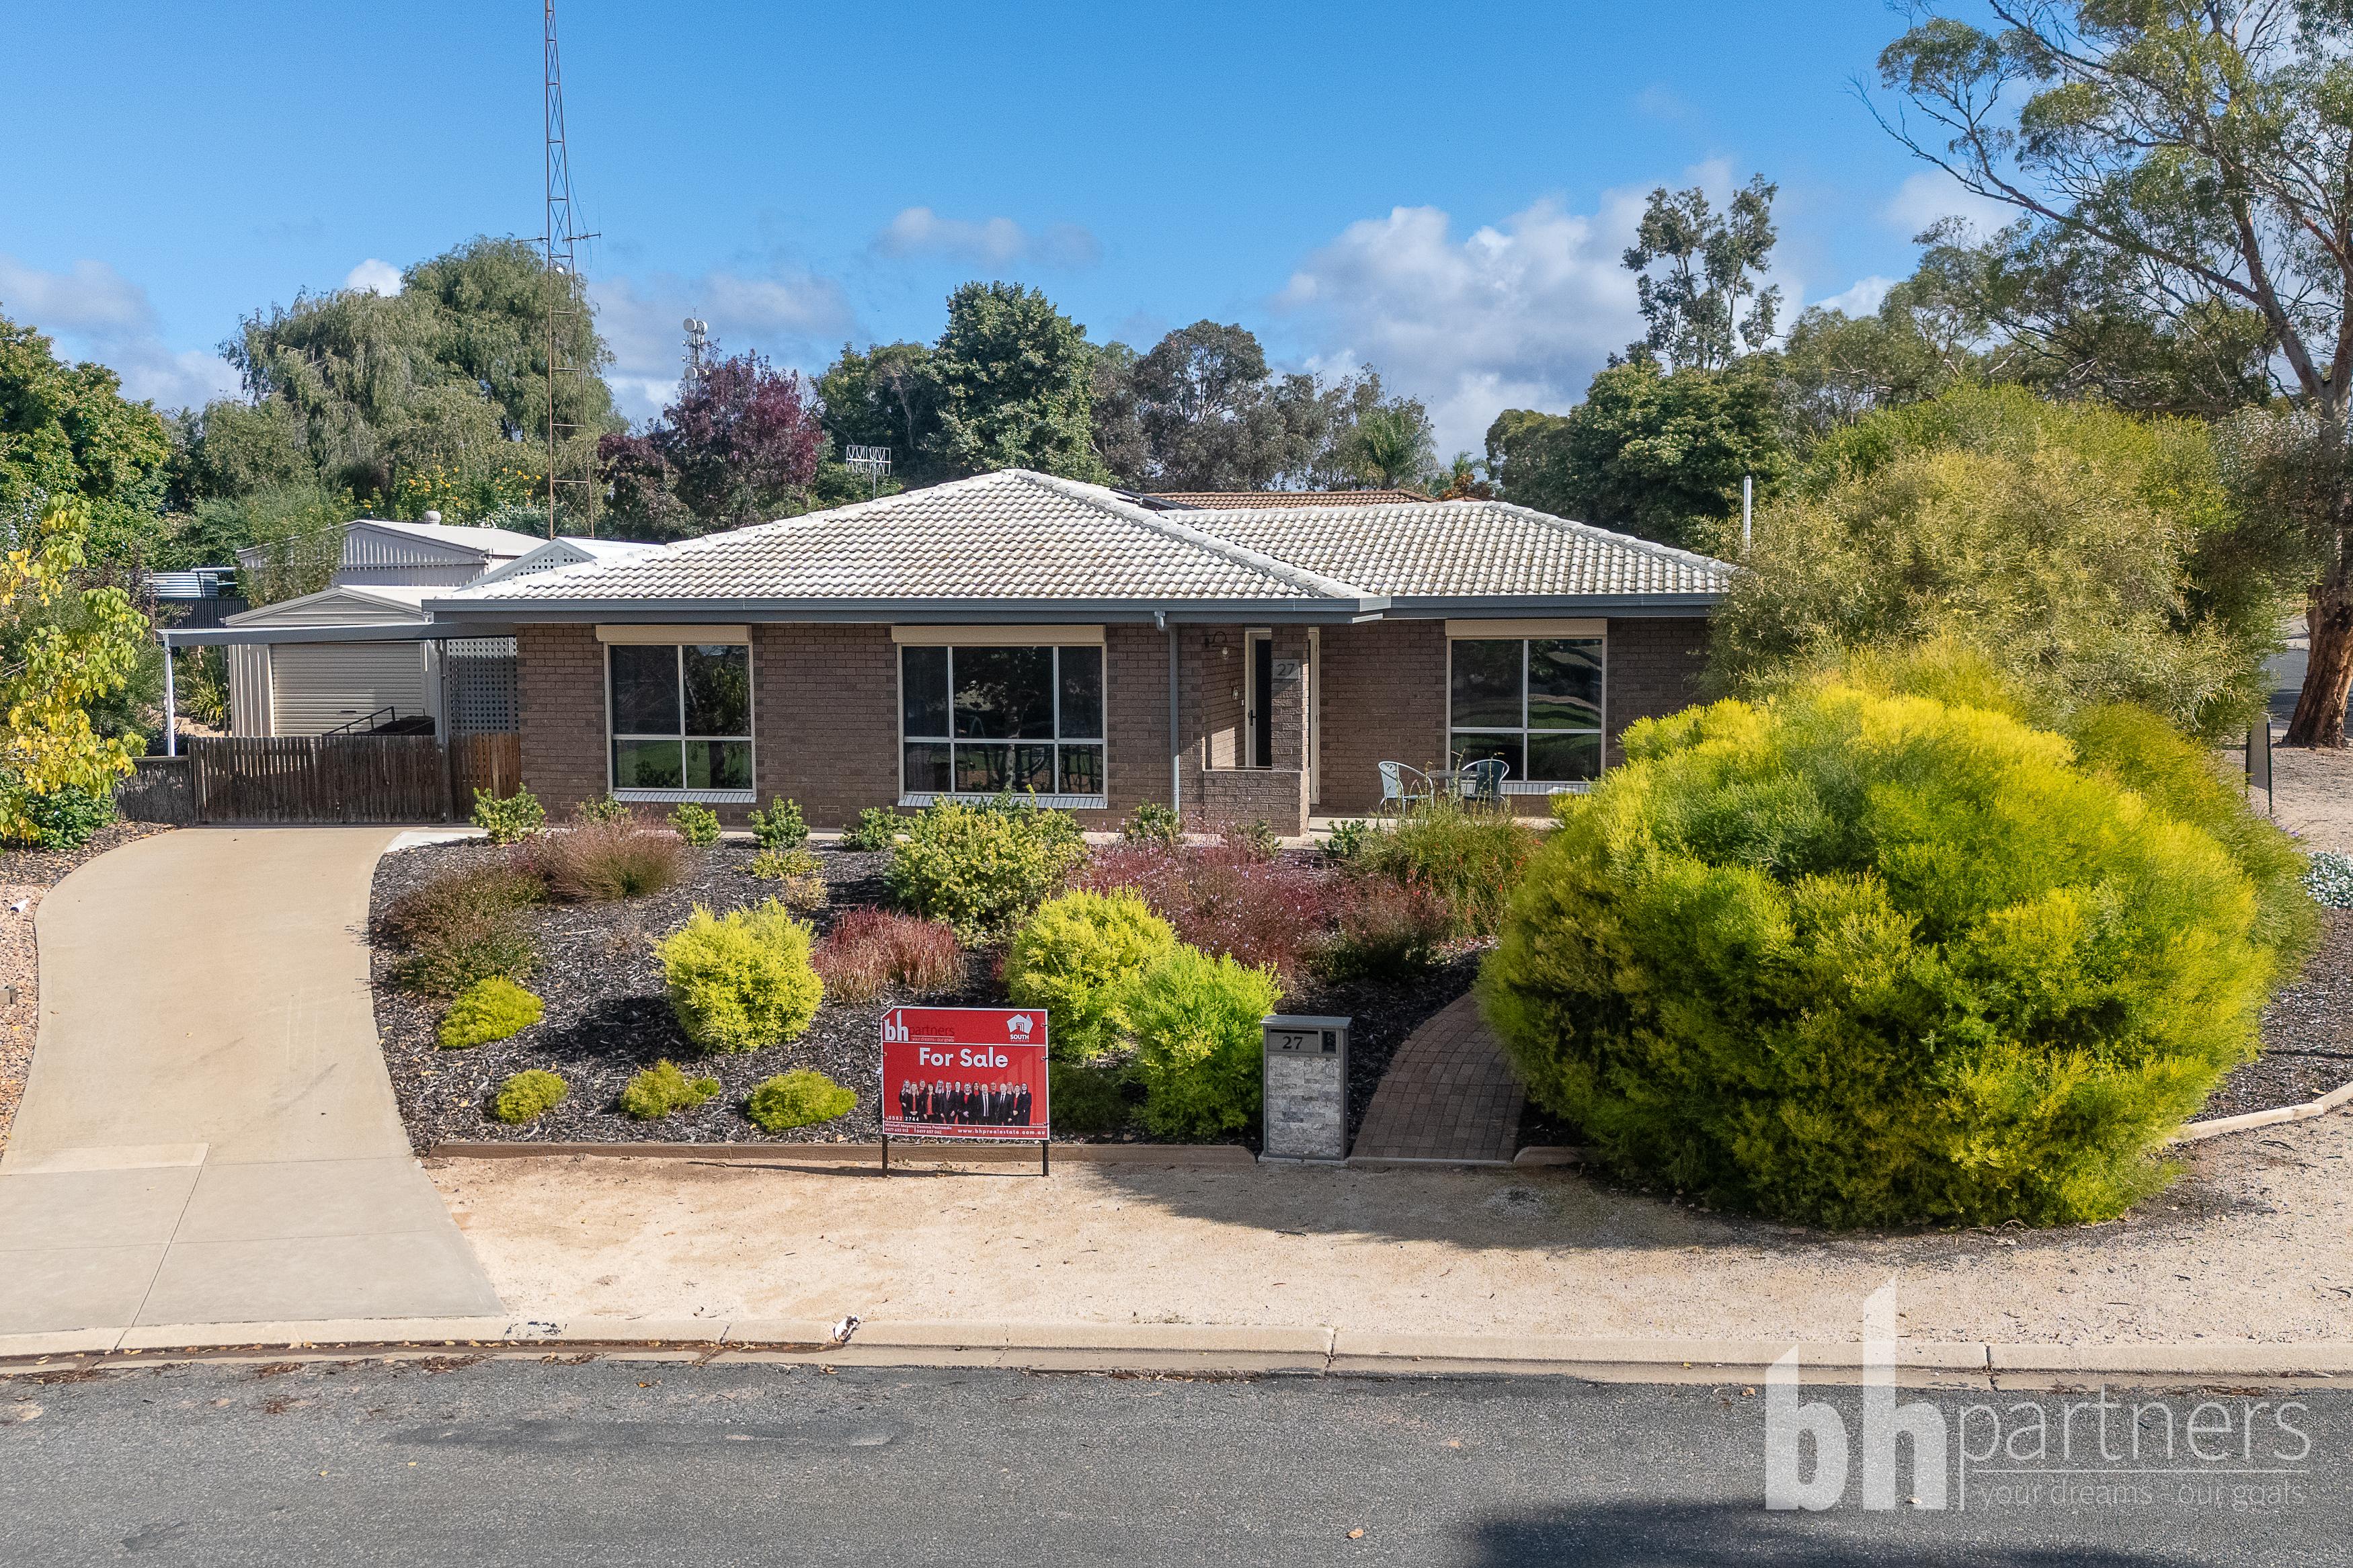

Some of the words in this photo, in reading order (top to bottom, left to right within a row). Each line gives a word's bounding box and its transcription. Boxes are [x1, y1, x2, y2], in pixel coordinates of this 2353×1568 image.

[1277, 663, 1295, 676] 27
[885, 1009, 908, 1041] bh
[909, 1025, 955, 1037] partners
[1282, 1036, 1303, 1049] 27
[919, 1047, 953, 1067] For
[960, 1047, 1008, 1068] Sale
